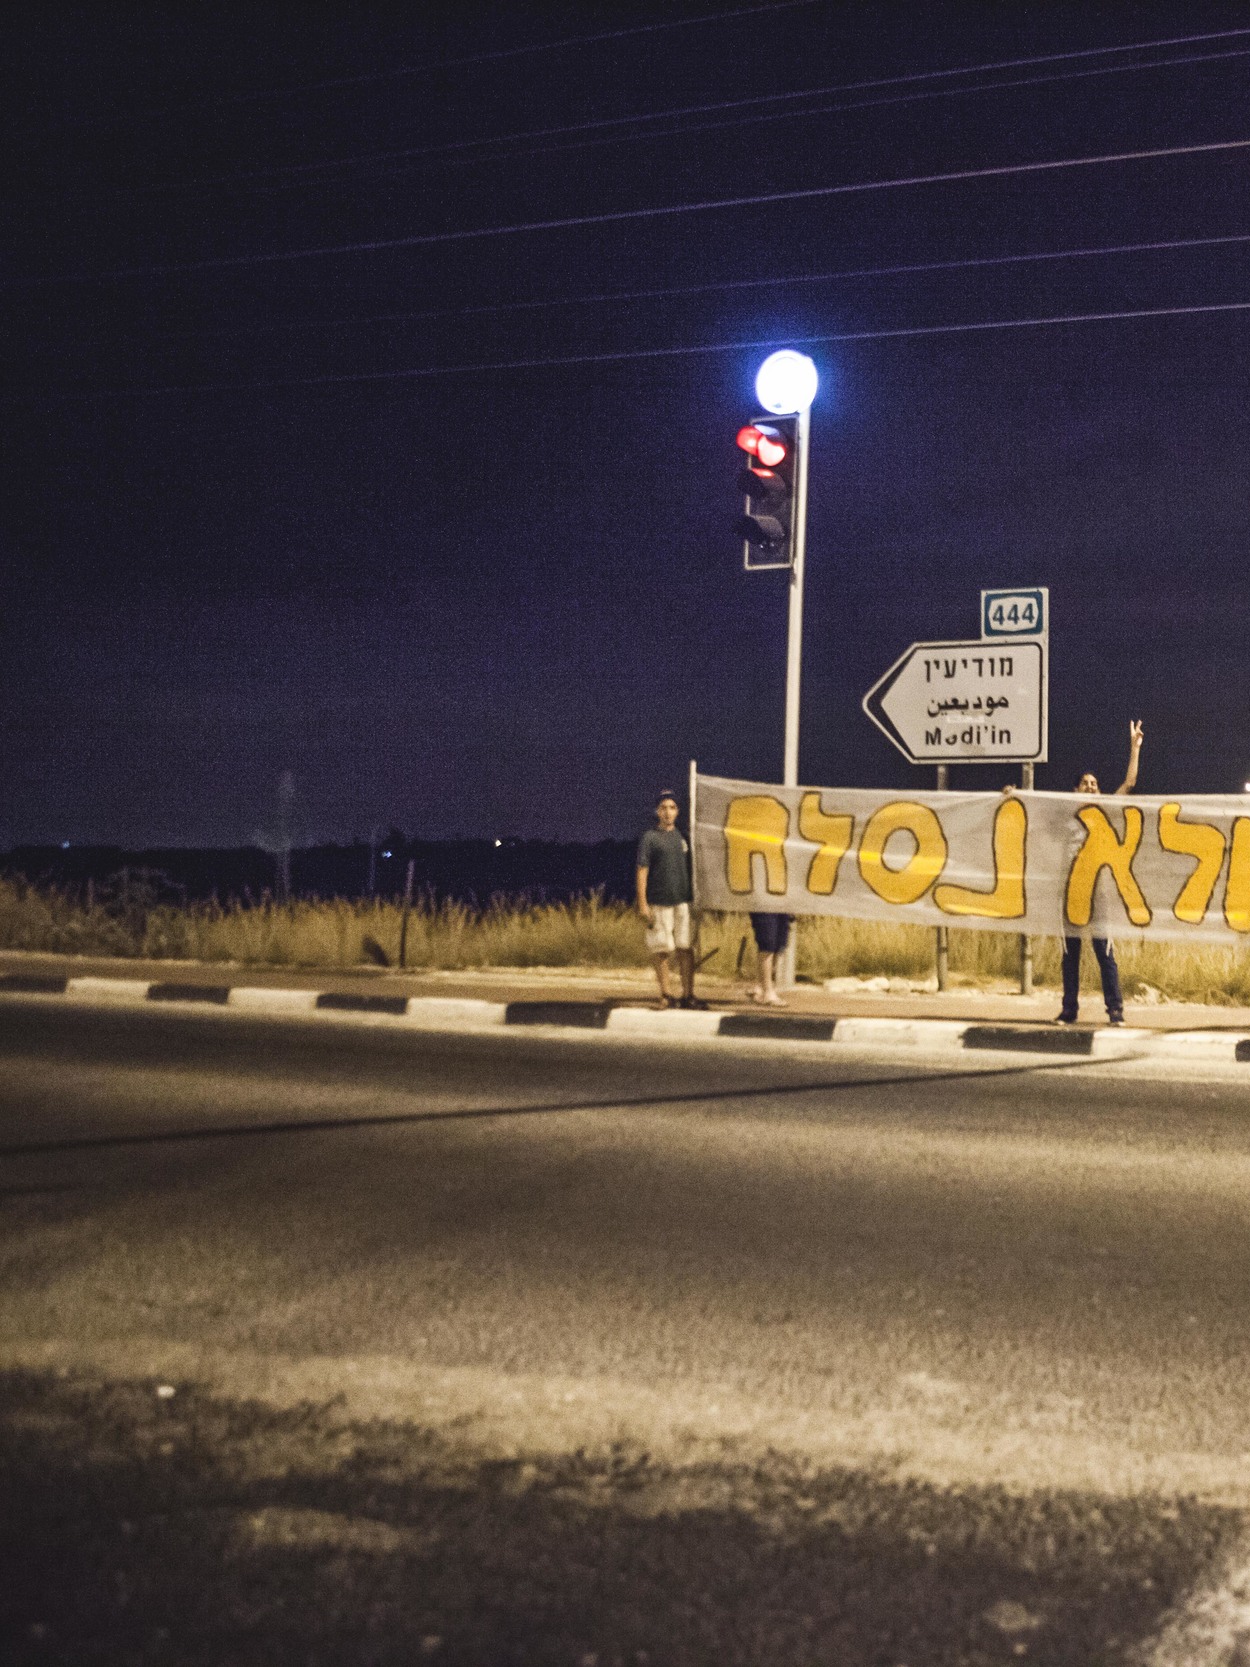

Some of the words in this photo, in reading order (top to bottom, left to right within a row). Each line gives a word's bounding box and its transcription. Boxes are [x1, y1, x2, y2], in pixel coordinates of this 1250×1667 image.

[992, 603, 1035, 625] 444
[924, 657, 1013, 682] מודיעין
[925, 725, 1011, 746] Modi'in
[722, 790, 1027, 919] נסלח
